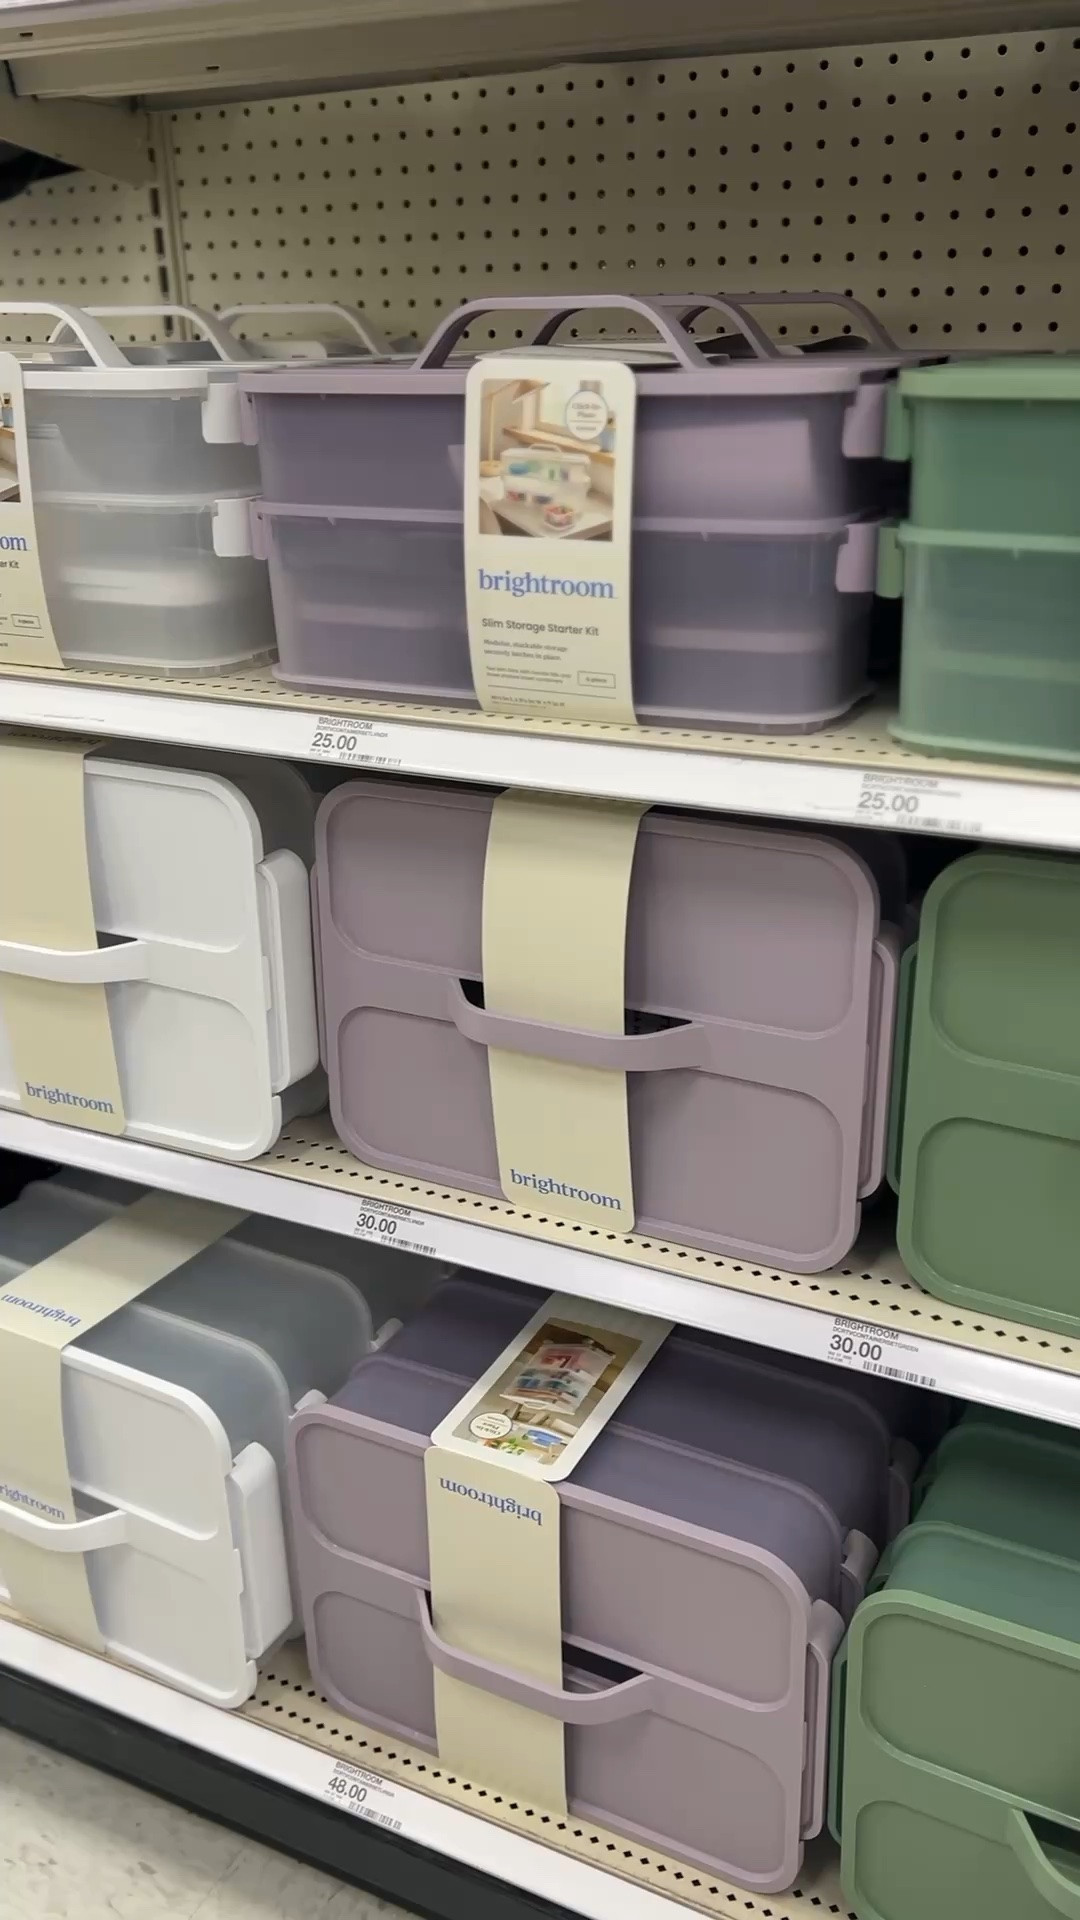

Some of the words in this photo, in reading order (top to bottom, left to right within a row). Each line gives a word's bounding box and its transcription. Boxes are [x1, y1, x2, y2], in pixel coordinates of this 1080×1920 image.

[478, 568, 616, 598] brightroom
[482, 618, 504, 628] Slim
[505, 620, 546, 634] Storage
[547, 623, 583, 635] Starter
[585, 626, 600, 636] Kit
[318, 717, 373, 730] BRIGHTROOM
[312, 732, 357, 751] 25.00
[863, 773, 938, 787] BRIGHTROOM
[857, 791, 919, 812] 25.00
[25, 1082, 115, 1114] brightroom
[510, 1169, 622, 1210] brightroom
[361, 1199, 411, 1216] BRIGHTROOM
[357, 1213, 397, 1235] 30.00
[2, 1294, 81, 1327] brightroom
[834, 1317, 899, 1340] BRIGHTROOM
[830, 1334, 882, 1360] 30.00
[0, 1484, 65, 1520] rightroom
[439, 1477, 542, 1526] brightroom
[335, 1761, 383, 1785] BRIGHTROOM
[328, 1777, 367, 1802] 48.00
